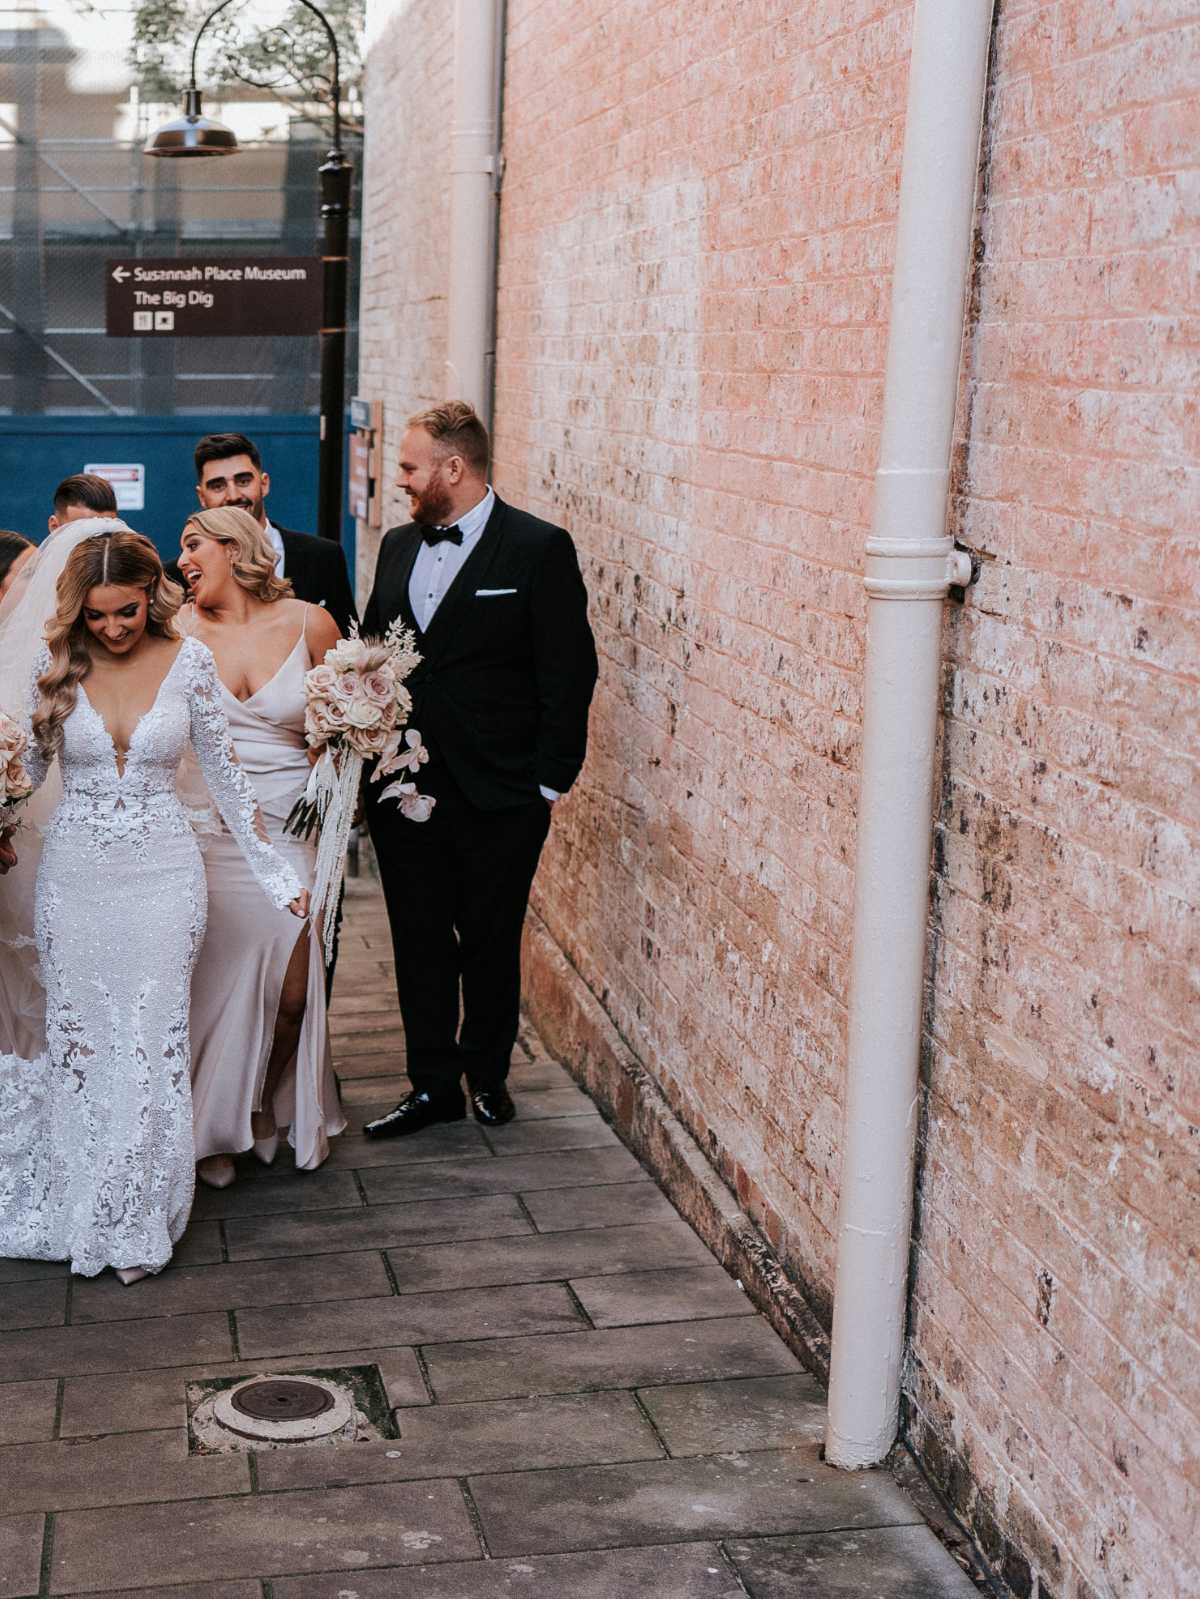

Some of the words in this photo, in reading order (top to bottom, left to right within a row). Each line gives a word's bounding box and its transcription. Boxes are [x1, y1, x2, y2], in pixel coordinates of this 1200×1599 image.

[133, 266, 202, 281] Susannah
[204, 266, 242, 281] Place
[244, 266, 306, 281] Museum
[133, 291, 161, 305] The
[163, 291, 186, 308] Big
[188, 291, 214, 308] Dig
